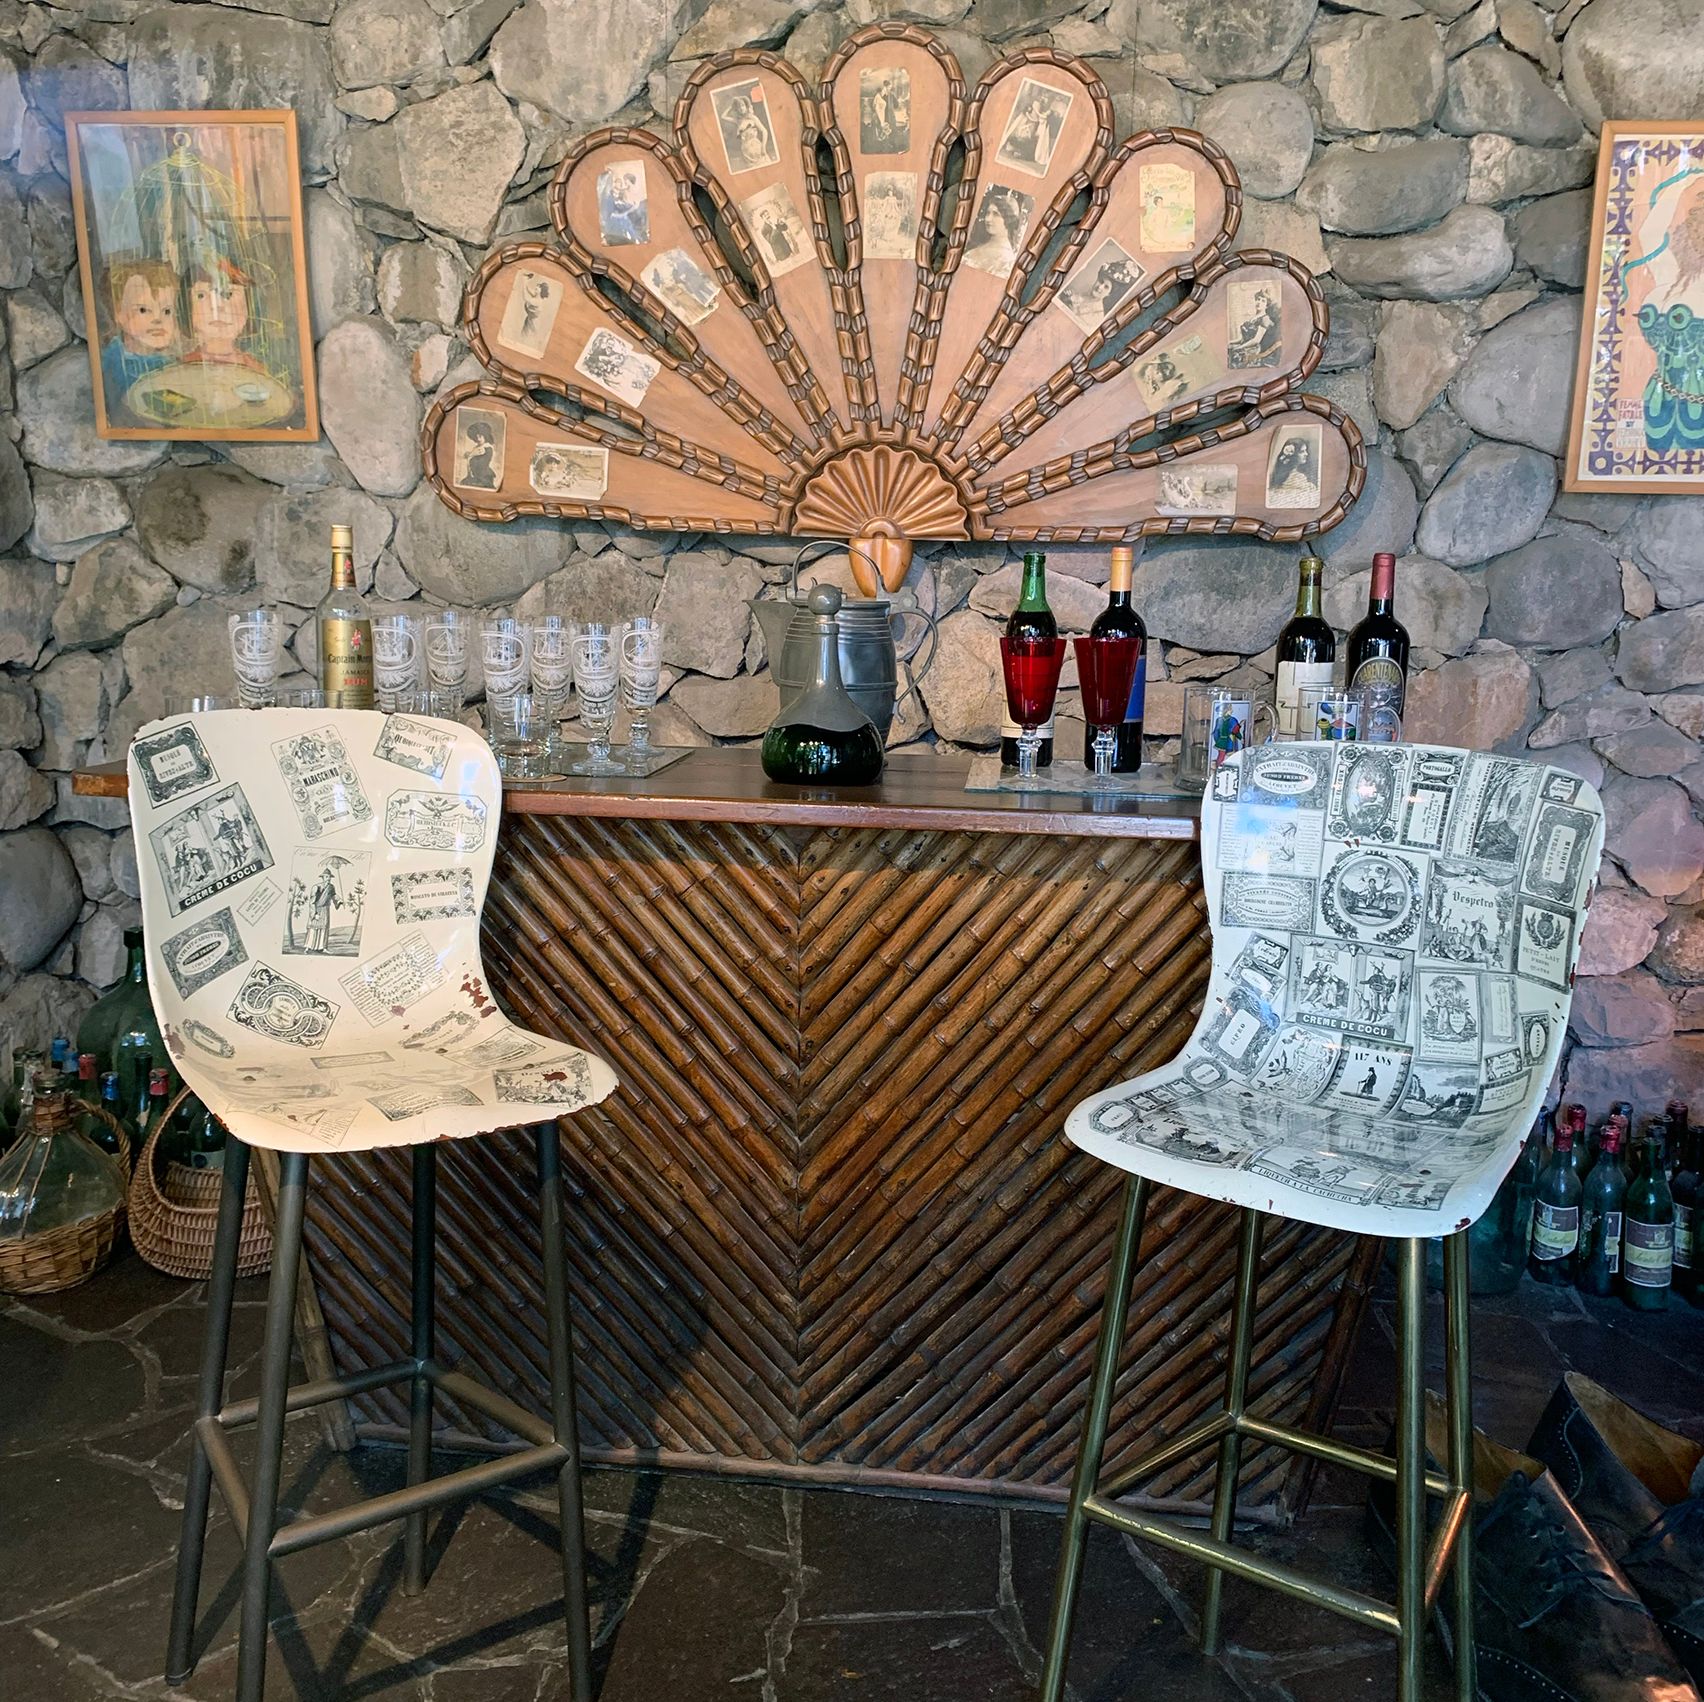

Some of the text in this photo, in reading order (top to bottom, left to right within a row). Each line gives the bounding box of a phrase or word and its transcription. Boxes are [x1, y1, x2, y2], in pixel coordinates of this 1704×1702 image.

[327, 654, 355, 665] Captain
[343, 678, 368, 686] RUM
[1423, 763, 1452, 773] PORTOGALLO
[184, 863, 258, 907] CREME DE COCU
[1452, 890, 1495, 909] Vespetro
[1302, 1014, 1388, 1037] CREME DE COCU
[1355, 1052, 1393, 1066] 117 ANS
